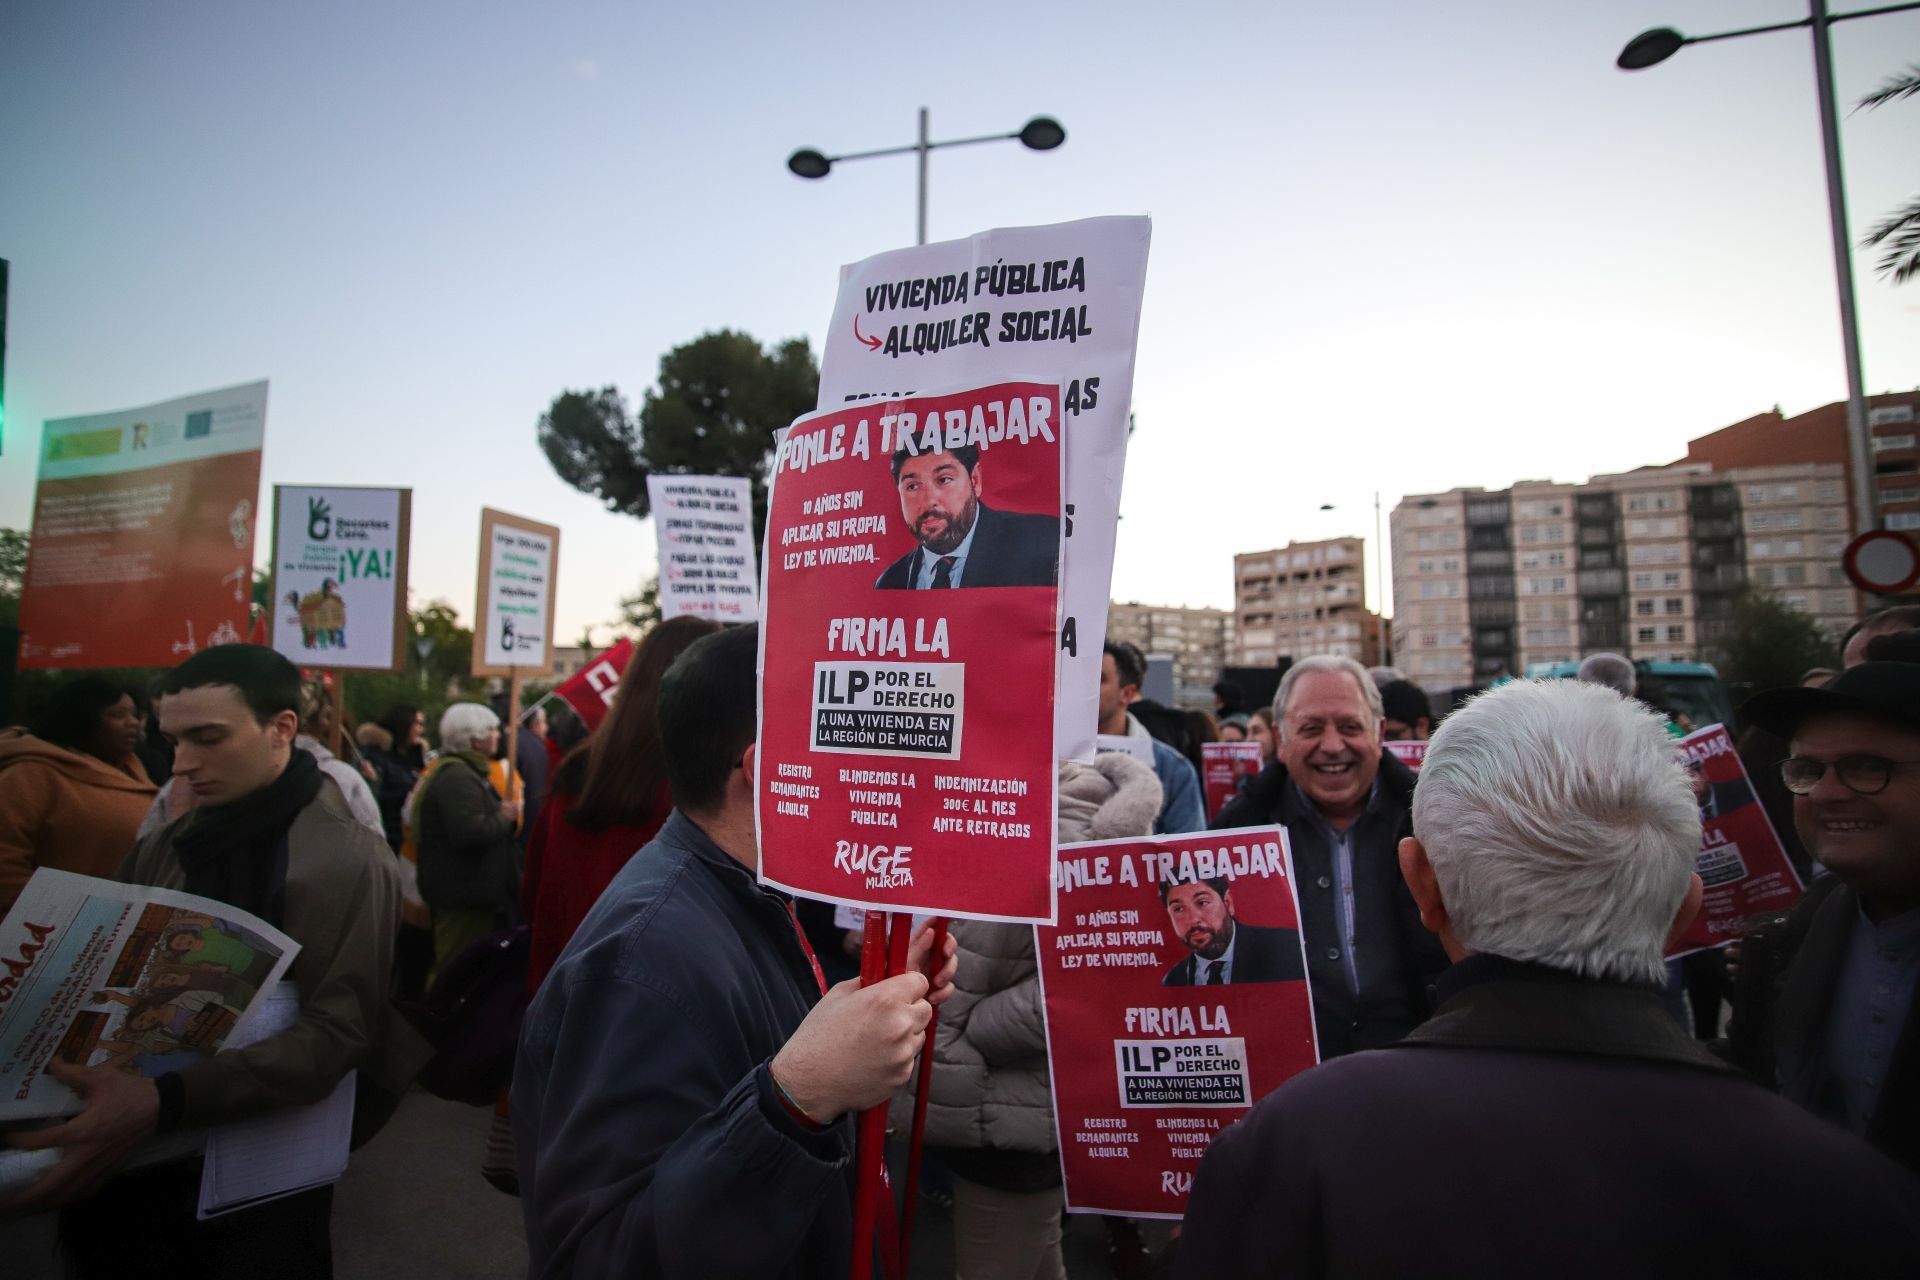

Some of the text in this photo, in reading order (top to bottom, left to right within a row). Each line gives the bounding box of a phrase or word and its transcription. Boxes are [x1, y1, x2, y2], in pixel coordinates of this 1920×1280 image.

[866, 257, 1085, 313] VIVIENDA PÚBLICA
[883, 305, 1092, 358] ALQUILER SOCIAL
[779, 397, 1054, 473] PONLE A TRABAJAR
[804, 491, 863, 515] 10 AÑOS SIN
[782, 515, 886, 546] APLICAR SU PROPIA
[339, 548, 391, 583] ¡YA!
[784, 552, 801, 570] LEY
[802, 550, 816, 566] DE
[828, 618, 949, 658] FIRMA LA
[819, 670, 869, 704] ILP
[875, 671, 936, 687] POR EL
[873, 691, 955, 708] DERECHO
[820, 714, 950, 730] A UNA VIVIENDA EN
[819, 729, 947, 747] LA REGIÓN DE MURCIA
[779, 764, 811, 779] REGISTRO
[840, 769, 915, 788] BLINDEMOS LA
[771, 781, 820, 799] DEMANDANTES
[935, 775, 1027, 795] INDEMNIZACIÓN
[850, 790, 901, 808] VIVIENDA
[943, 799, 1016, 816] 300€ AL MES
[777, 802, 809, 819] ALQUILER
[851, 810, 897, 828] PÚBLICA
[933, 817, 1030, 838] ANTE RETRASOS
[834, 840, 912, 877] RUGE
[1058, 843, 1285, 893] ONLE A TRABAJAR
[866, 872, 912, 889] MURCIA
[1076, 910, 1138, 927] 10 AÑOS SIN
[1056, 931, 1164, 950] APLICAR SU PROPIA
[1062, 955, 1082, 969] LEY
[1087, 954, 1101, 967] DE
[14, 1008, 50, 1059] ATRACO
[50, 988, 63, 1008] de
[59, 976, 72, 987] la
[70, 924, 104, 973] vivienda
[15, 1037, 59, 1100] BANCOS
[56, 1023, 67, 1031] y
[64, 956, 105, 1018] FONDOS
[1125, 1005, 1231, 1036] FIRMA LA
[22, 1031, 48, 1062] tiene
[1175, 1045, 1223, 1057] POR EL
[1122, 1046, 1171, 1072] ILP
[1176, 1059, 1240, 1072] DERECHO
[1128, 1077, 1240, 1088] A UNA VIVIENDA EN
[1130, 1089, 1240, 1100] LA REGIÓN DE MURCIA
[1084, 1119, 1126, 1128] REGISTRO
[1156, 1118, 1219, 1129] BLINDEMOS LA
[1076, 1133, 1138, 1143] DEMANDANTES
[1168, 1133, 1210, 1143] VIVIENDA
[1088, 1148, 1129, 1158] ALQUILER
[1172, 1147, 1204, 1158] PÚBLIC
